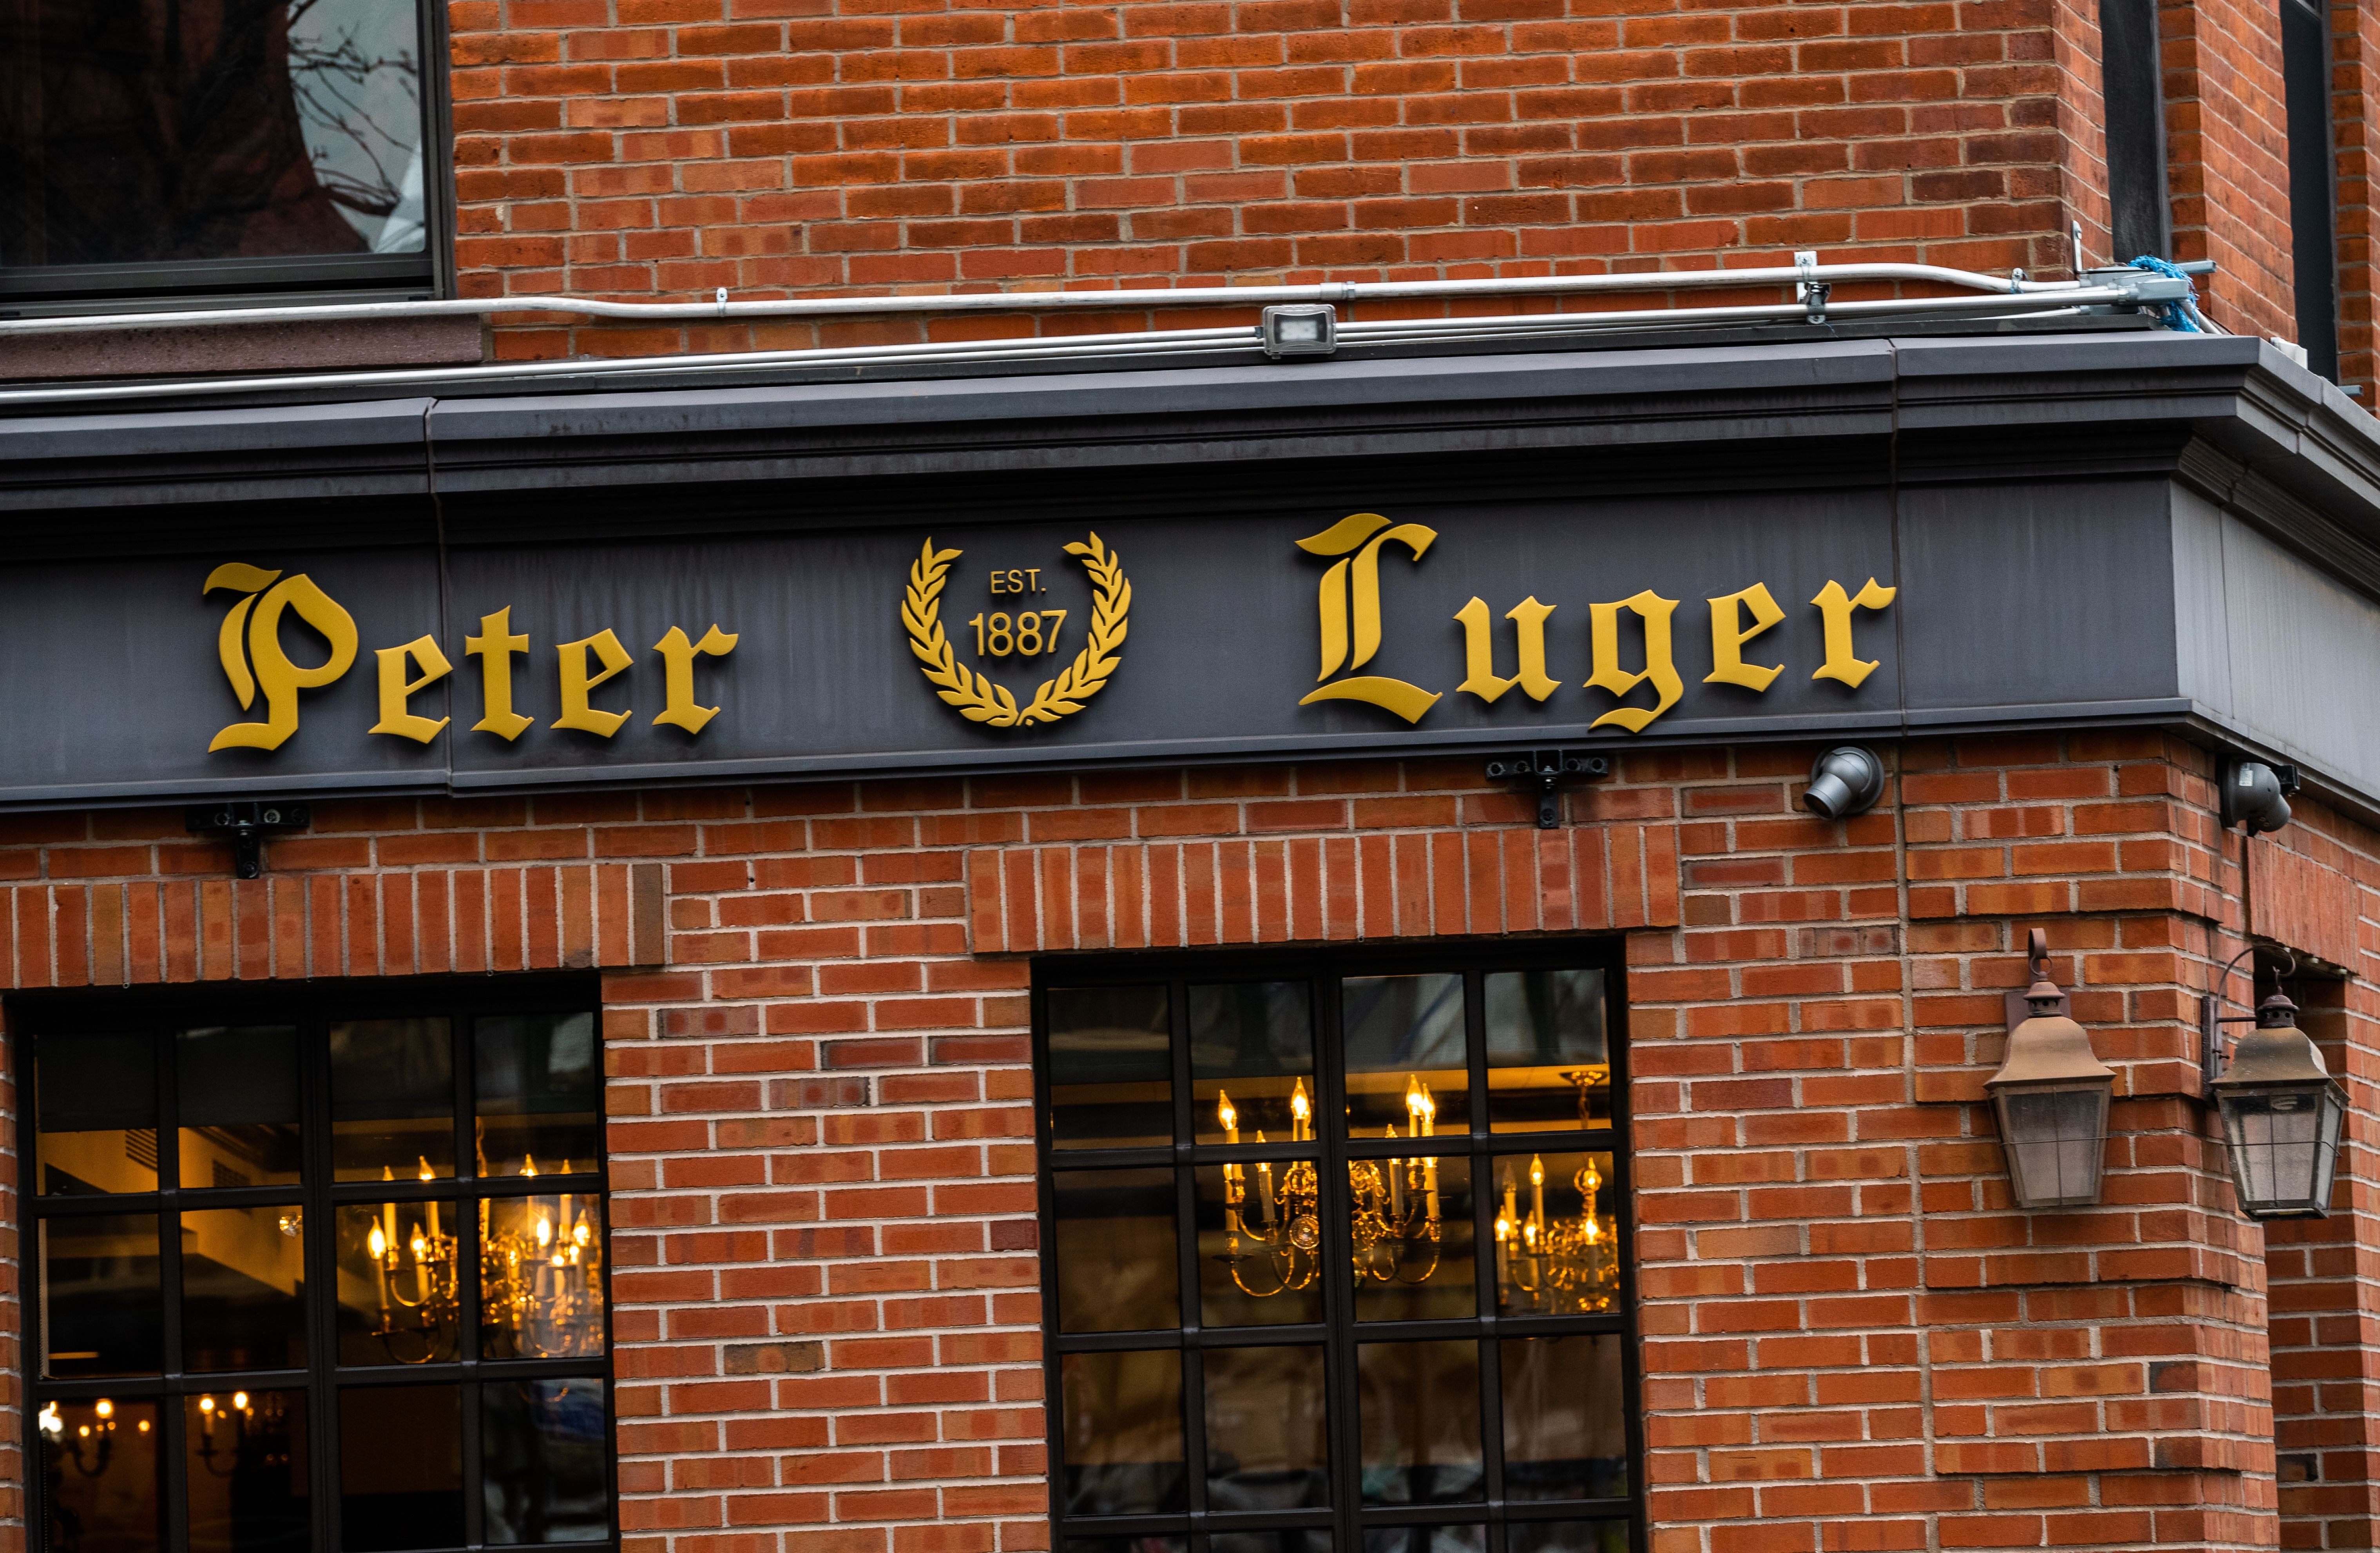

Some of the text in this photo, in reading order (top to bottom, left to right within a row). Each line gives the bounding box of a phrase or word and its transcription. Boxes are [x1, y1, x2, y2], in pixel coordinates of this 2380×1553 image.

[990, 569, 1046, 593] EST.
[204, 513, 1897, 752] Peter Luger
[969, 610, 1067, 656] 1887
